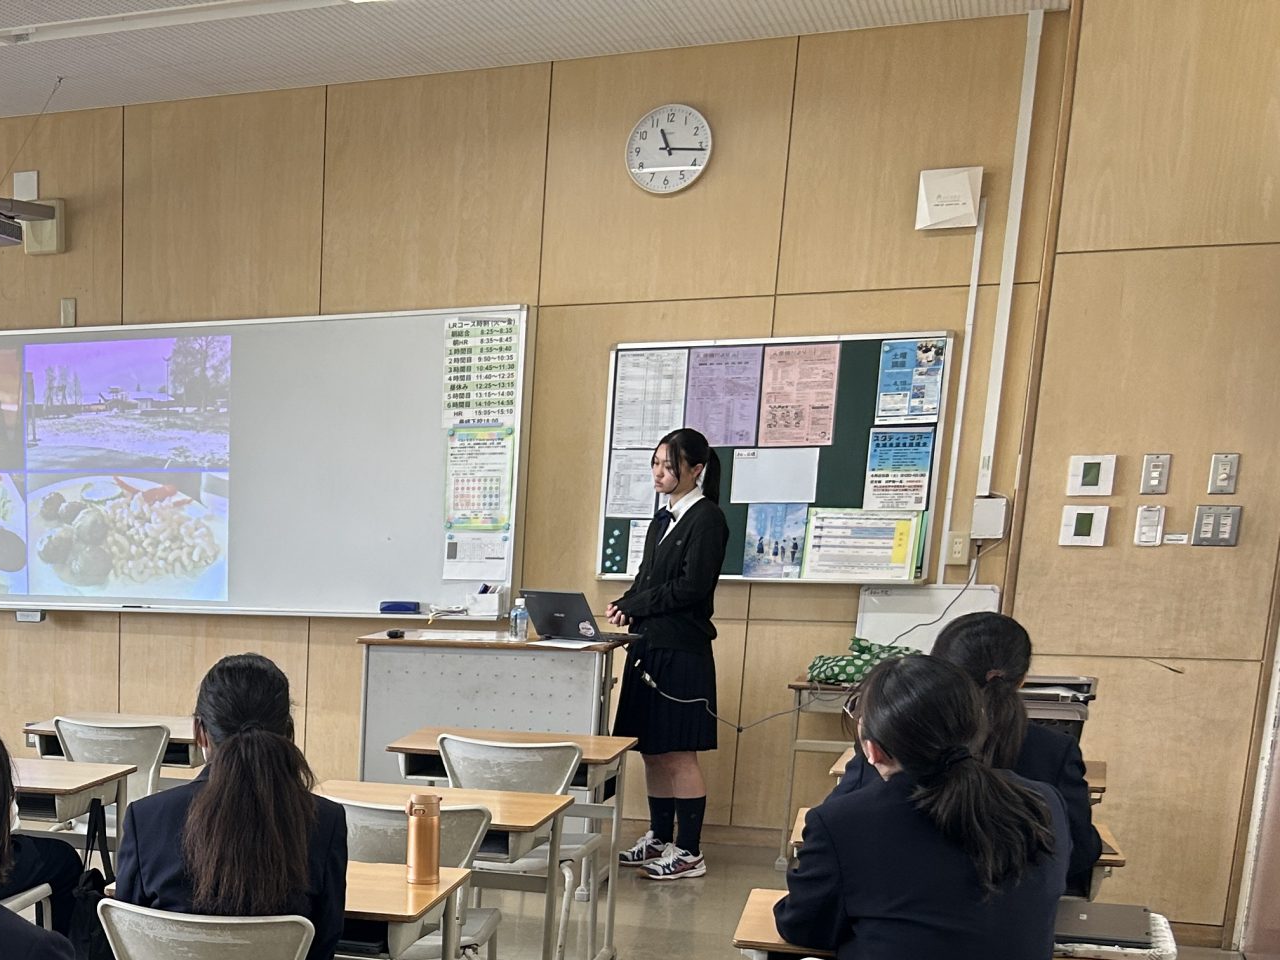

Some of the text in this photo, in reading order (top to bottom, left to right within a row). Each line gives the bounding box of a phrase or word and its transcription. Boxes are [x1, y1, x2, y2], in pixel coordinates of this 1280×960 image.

[667, 113, 675, 122] 12
[684, 116, 688, 126] 1
[652, 118, 659, 128] 11
[639, 131, 647, 140] 10
[693, 126, 699, 136] 2
[698, 141, 704, 150] 3
[635, 147, 640, 156] 9
[638, 162, 644, 171] 8
[691, 158, 696, 166] 4
[650, 173, 655, 182] 7
[680, 170, 685, 179] 5
[663, 177, 669, 185] 6
